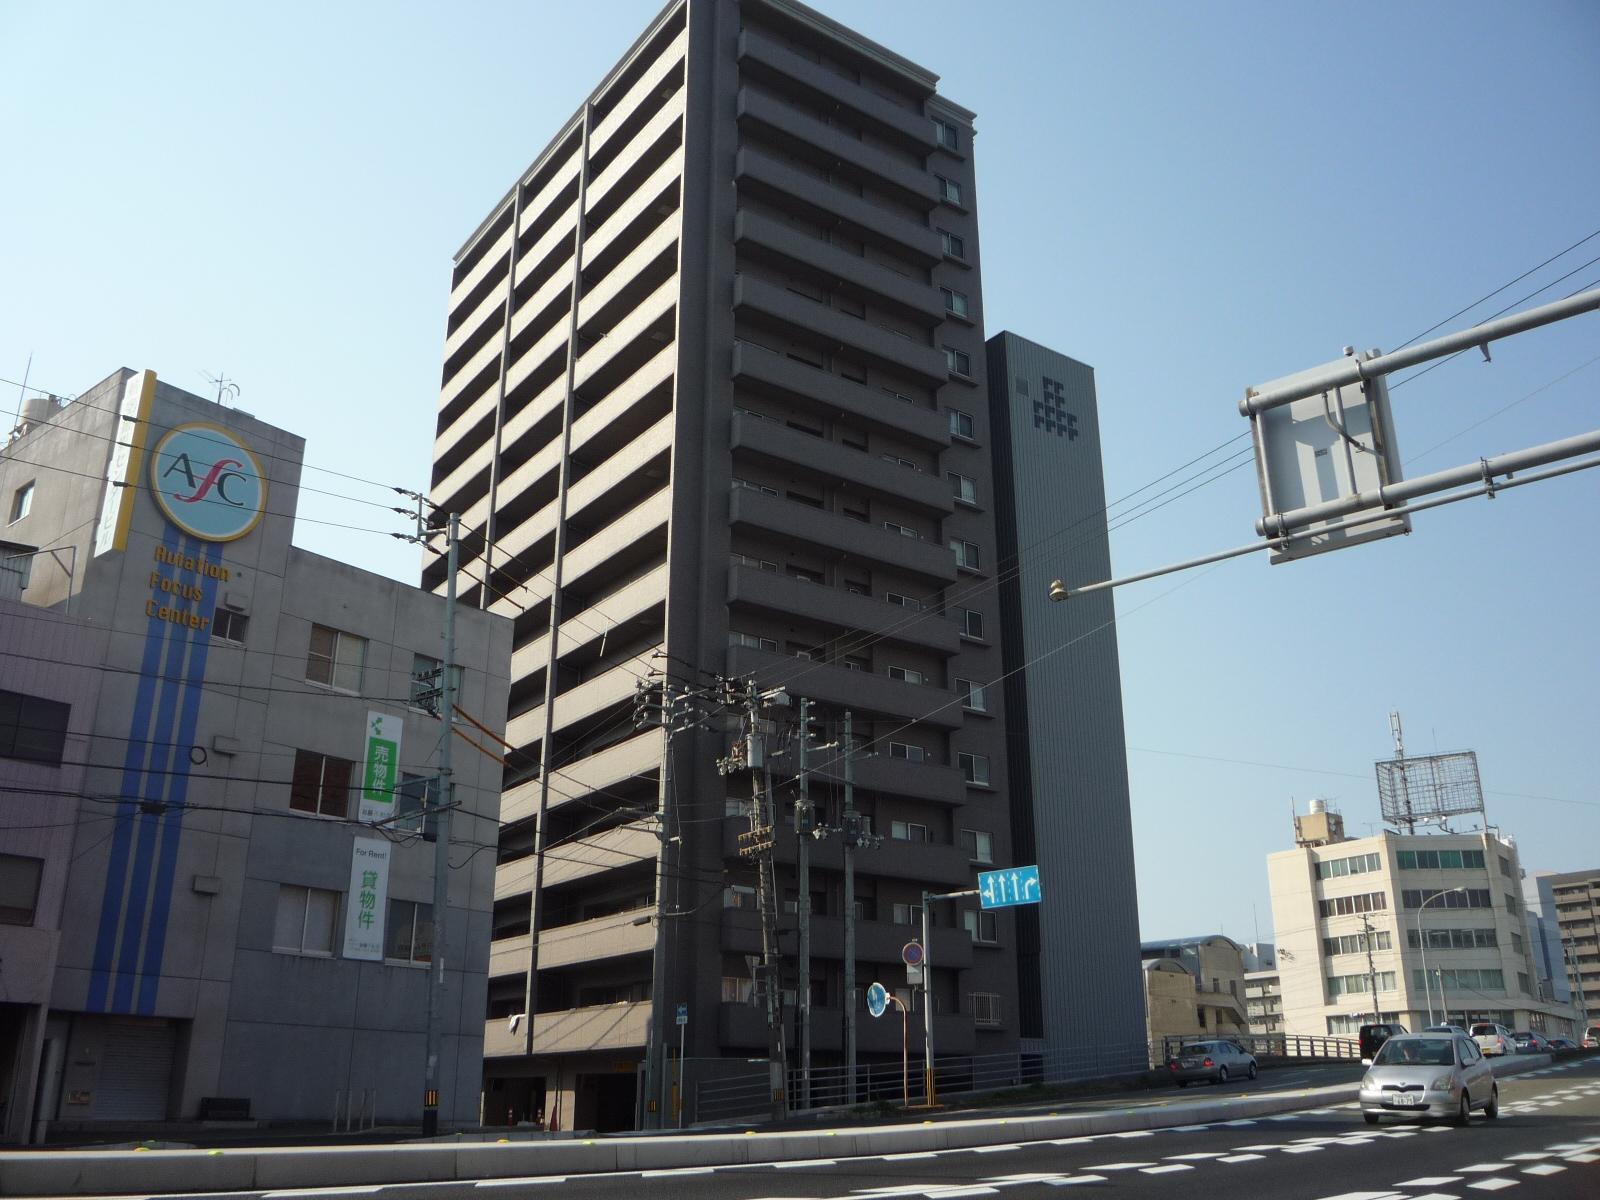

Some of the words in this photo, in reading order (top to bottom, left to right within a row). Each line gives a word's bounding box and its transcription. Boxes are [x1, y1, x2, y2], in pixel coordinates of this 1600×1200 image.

[149, 571, 204, 602] Focus
[145, 599, 210, 631] Center
[373, 745, 390, 796] 売物件
[356, 847, 368, 857] For
[358, 869, 378, 931] 貸物件
